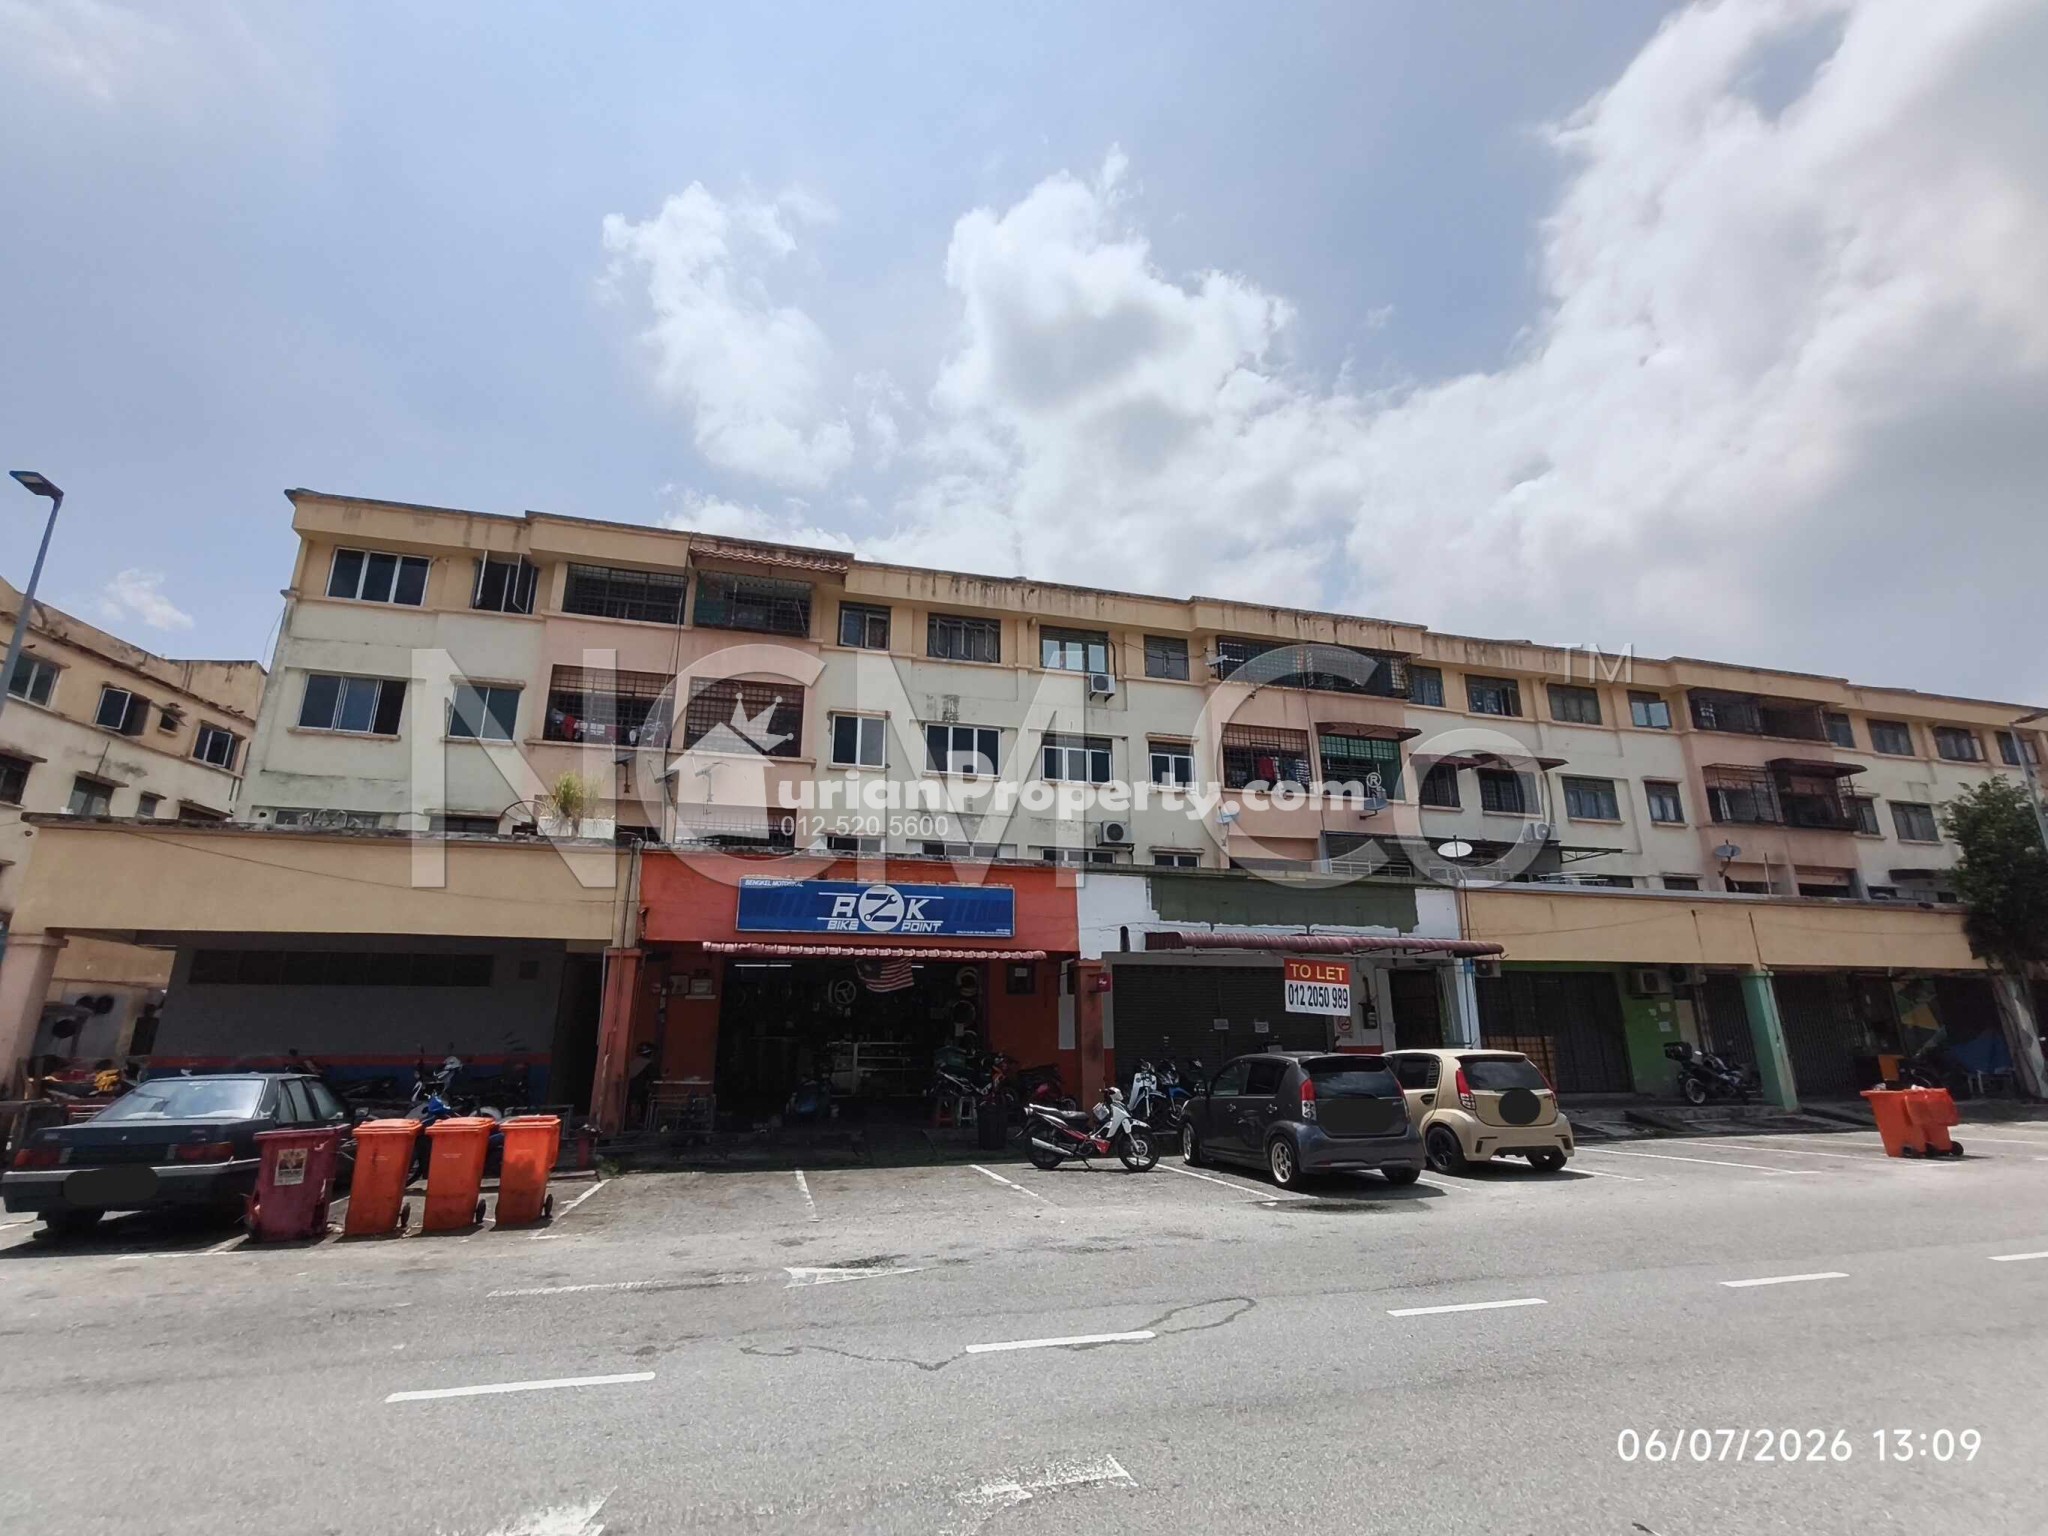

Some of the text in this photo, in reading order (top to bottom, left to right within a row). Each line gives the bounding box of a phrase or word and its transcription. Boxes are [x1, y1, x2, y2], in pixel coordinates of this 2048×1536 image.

[827, 920, 942, 933] BIKE POINT
[1290, 963, 1345, 981] TO LET
[1288, 984, 1348, 1009] 012 2050 989
